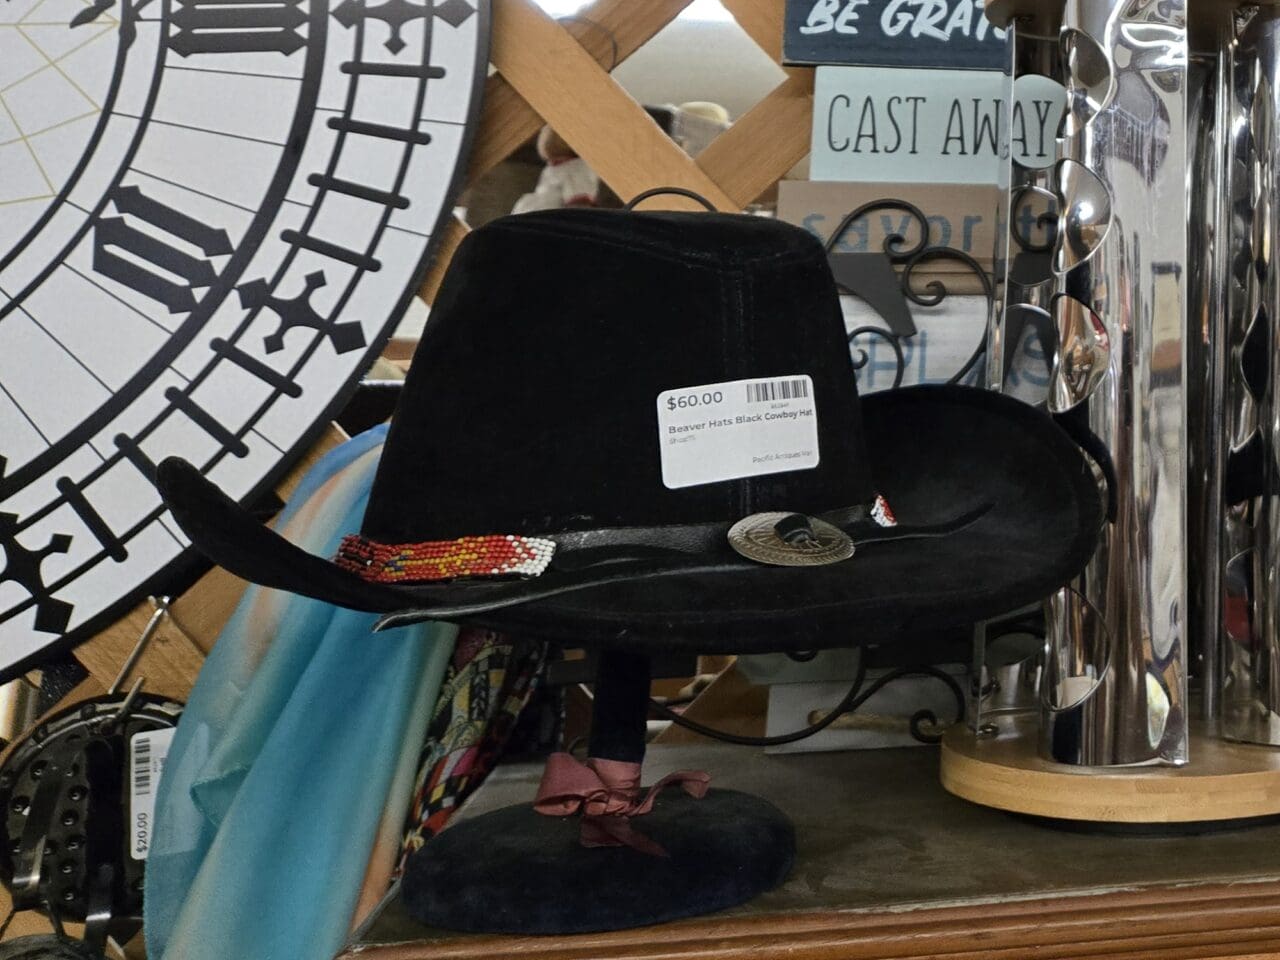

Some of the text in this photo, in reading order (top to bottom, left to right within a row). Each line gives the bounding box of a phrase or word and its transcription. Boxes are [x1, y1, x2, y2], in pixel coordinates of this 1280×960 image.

[827, 94, 1055, 159] CAST AWAY
[667, 391, 723, 411] $60.00
[668, 408, 813, 434] Beaver Hats Black Cowboy Hat
[136, 812, 148, 853] $20.00
